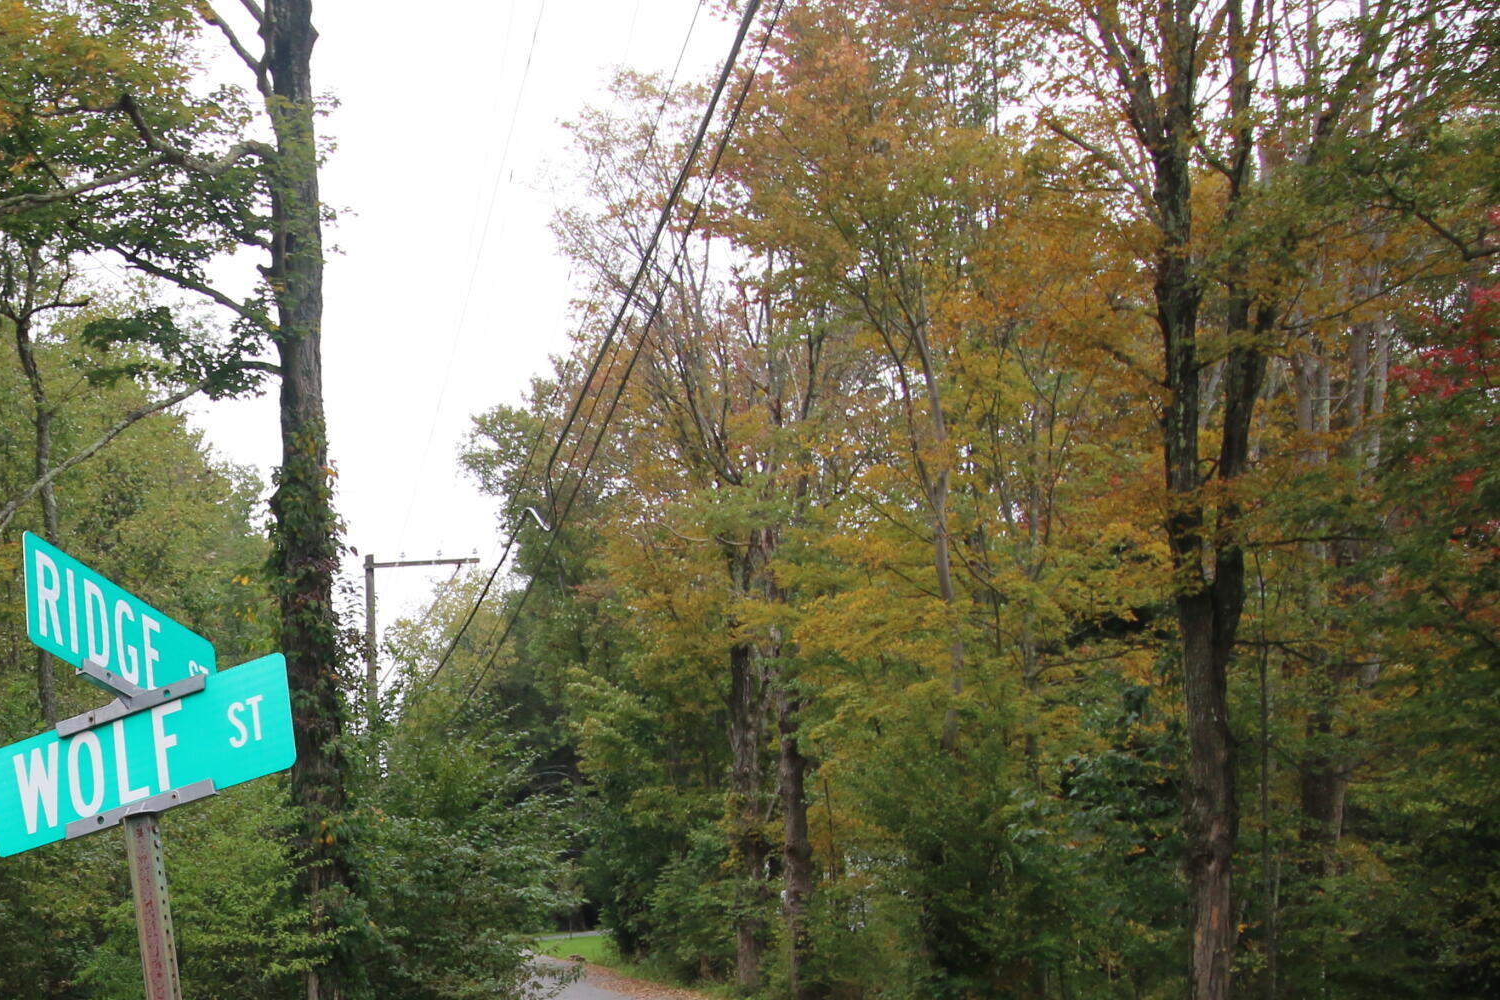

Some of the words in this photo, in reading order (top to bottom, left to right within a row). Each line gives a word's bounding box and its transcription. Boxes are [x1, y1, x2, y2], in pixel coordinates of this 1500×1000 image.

[35, 549, 161, 690] RIDGE
[12, 699, 183, 835] WOLF
[227, 694, 264, 749] ST
